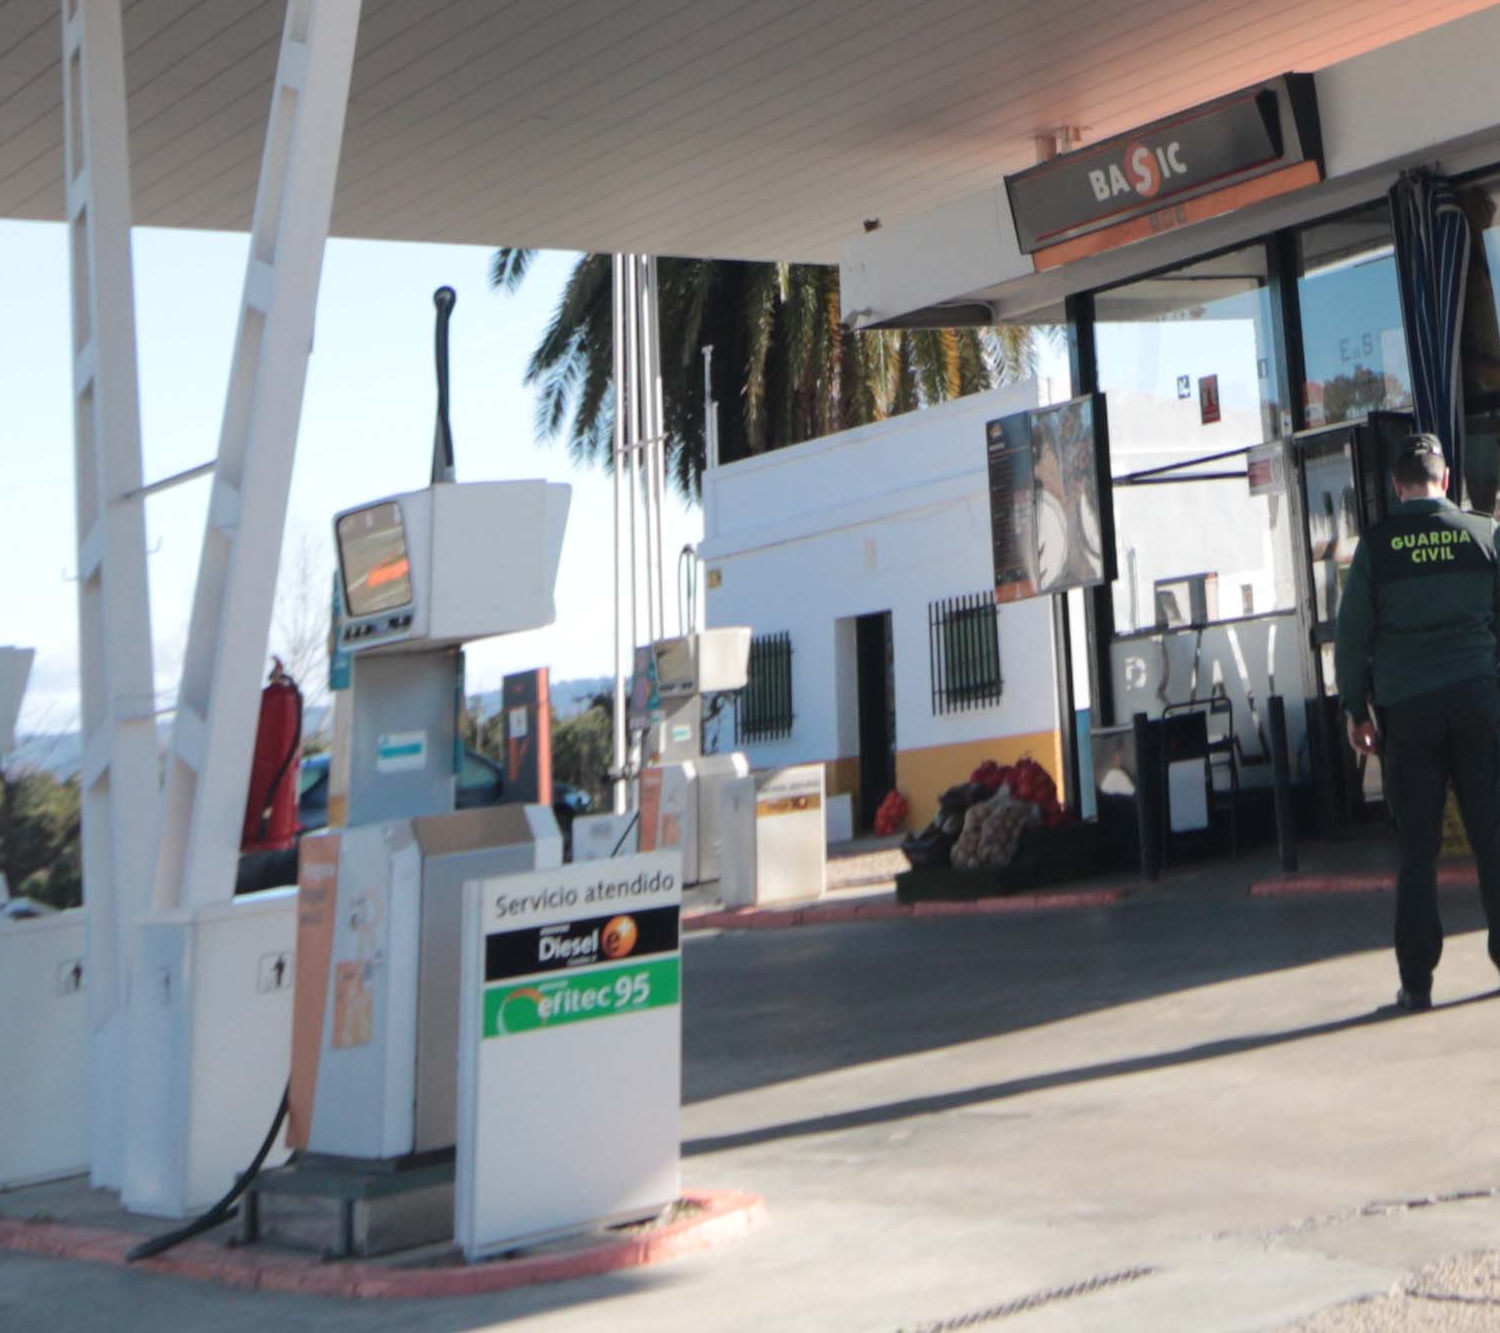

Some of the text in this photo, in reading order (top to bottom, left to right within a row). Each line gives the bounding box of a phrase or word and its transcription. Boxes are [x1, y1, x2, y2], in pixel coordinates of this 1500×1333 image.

[1088, 141, 1188, 201] BASIC
[1391, 529, 1471, 550] GUARDIA
[1411, 546, 1455, 563] CIVIL
[495, 870, 674, 918] Servicio atendido
[538, 929, 599, 962] Diesel
[537, 972, 649, 1019] efitec 95
